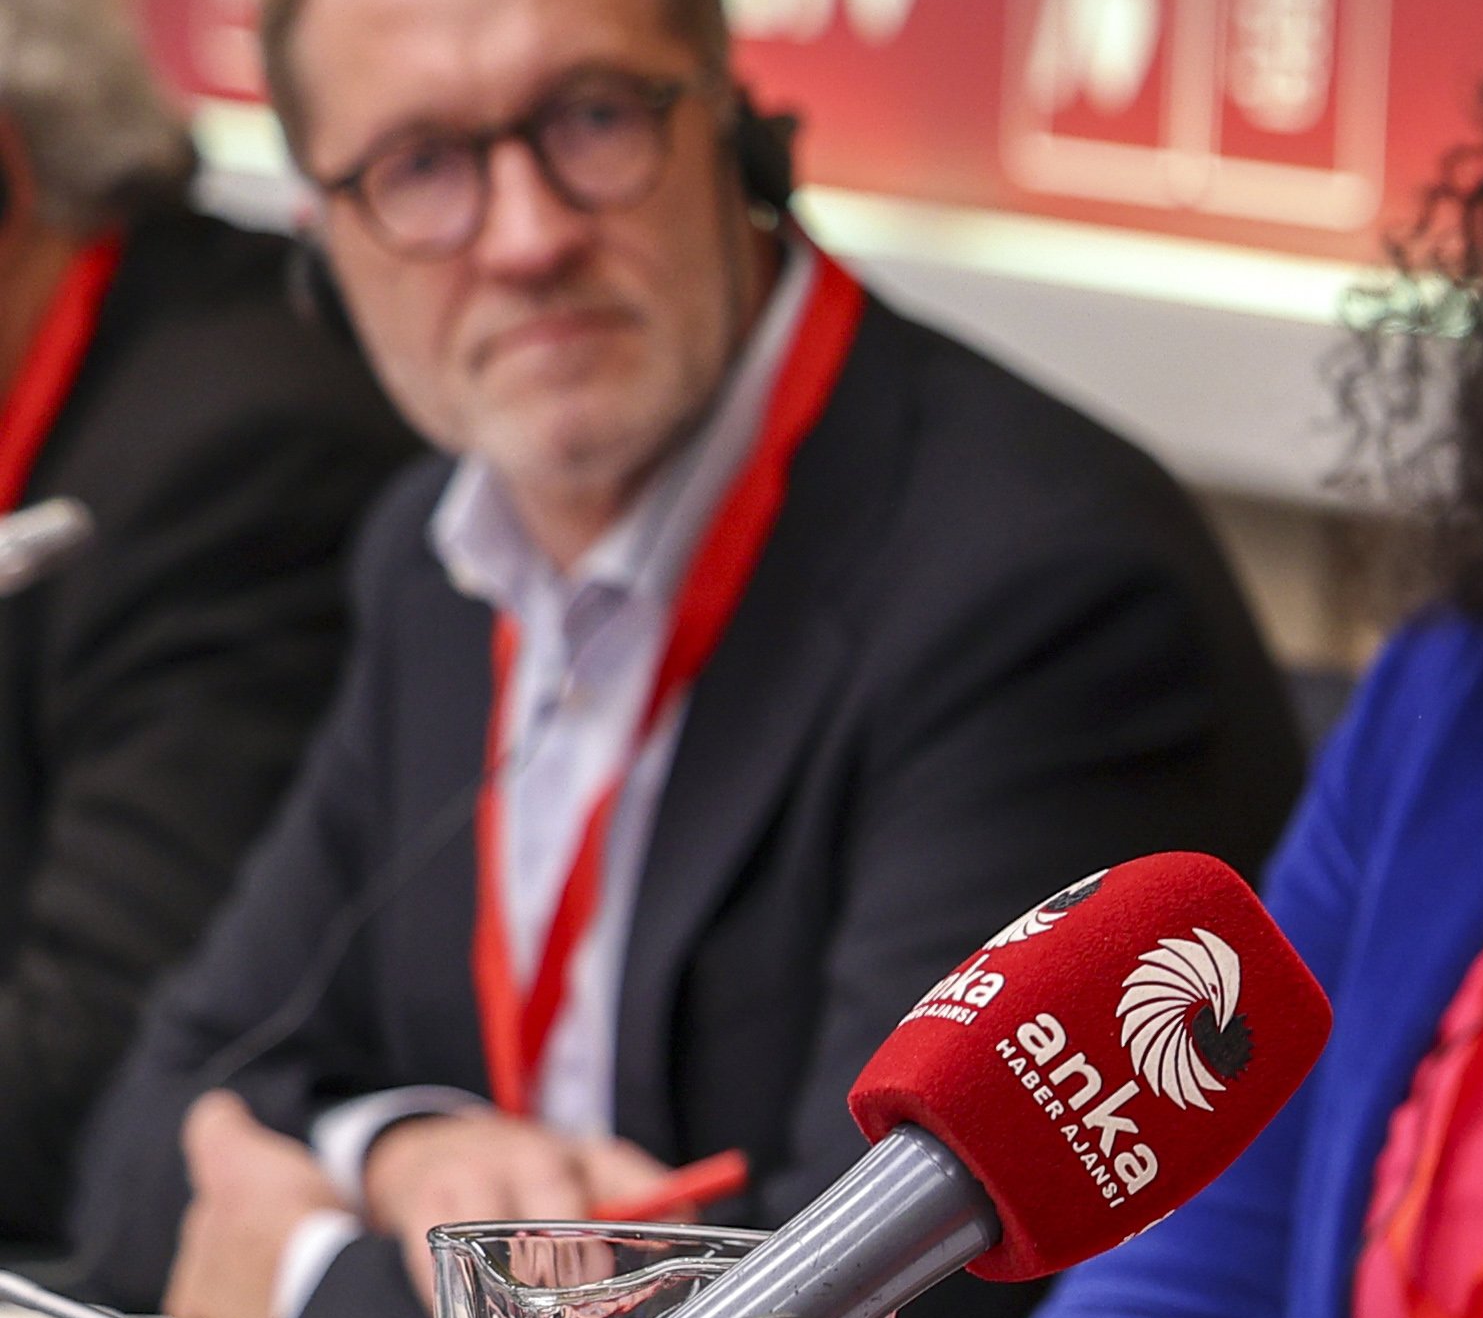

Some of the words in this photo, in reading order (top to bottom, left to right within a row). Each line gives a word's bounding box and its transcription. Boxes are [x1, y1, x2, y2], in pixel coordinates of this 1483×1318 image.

[995, 1038, 1064, 1121] HABER
[1060, 1123, 1126, 1209] AJANSI
[1016, 1012, 1160, 1196] anka
